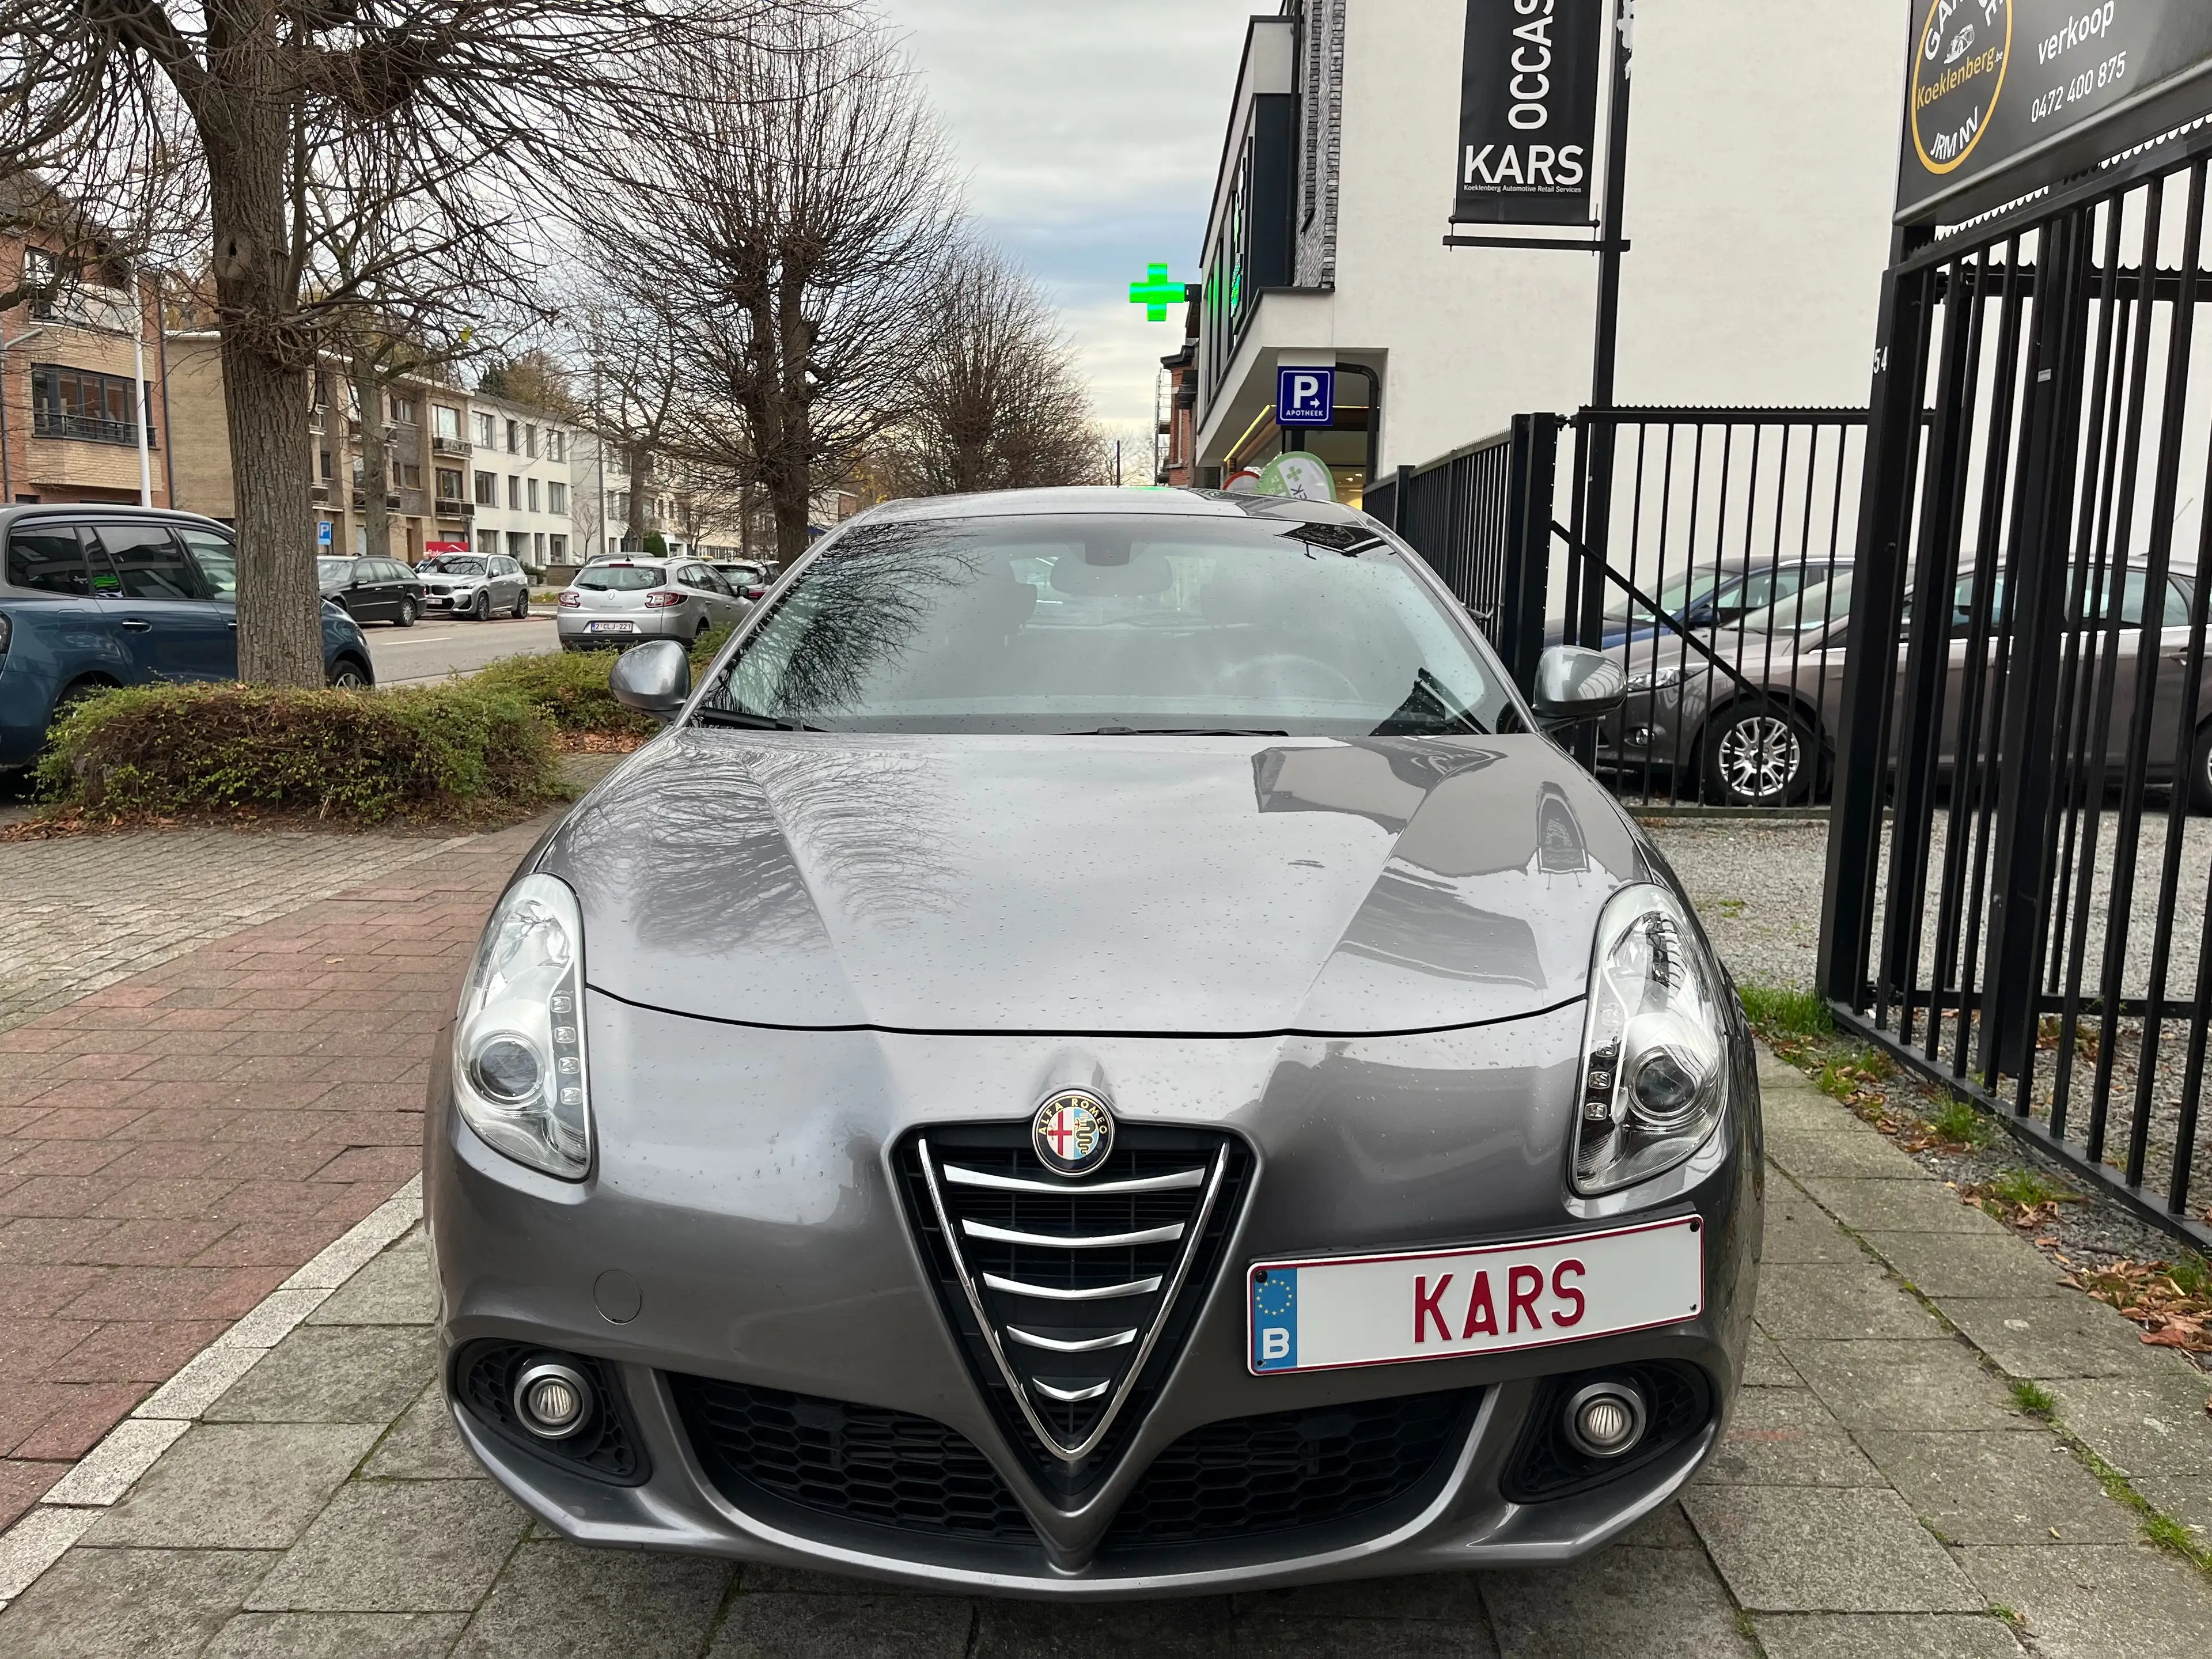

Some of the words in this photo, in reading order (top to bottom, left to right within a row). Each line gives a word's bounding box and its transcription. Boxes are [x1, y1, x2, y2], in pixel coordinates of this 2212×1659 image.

[2037, 0, 2115, 65] verkoop
[2031, 86, 2063, 123] 0472
[2067, 69, 2093, 103] 400
[2097, 50, 2127, 88] 875
[1930, 132, 1957, 160] JRM
[1960, 105, 1978, 149] NV
[1464, 145, 1584, 185] KARS
[1464, 184, 1501, 192] Koeklenberg
[1873, 346, 1888, 374] 54
[1293, 376, 1319, 408] P
[320, 524, 329, 537] P
[1038, 1102, 1064, 1135] ALFA
[1071, 1098, 1108, 1134] ROMEO
[1413, 1258, 1586, 1343] KARS
[1263, 1328, 1290, 1359] B
